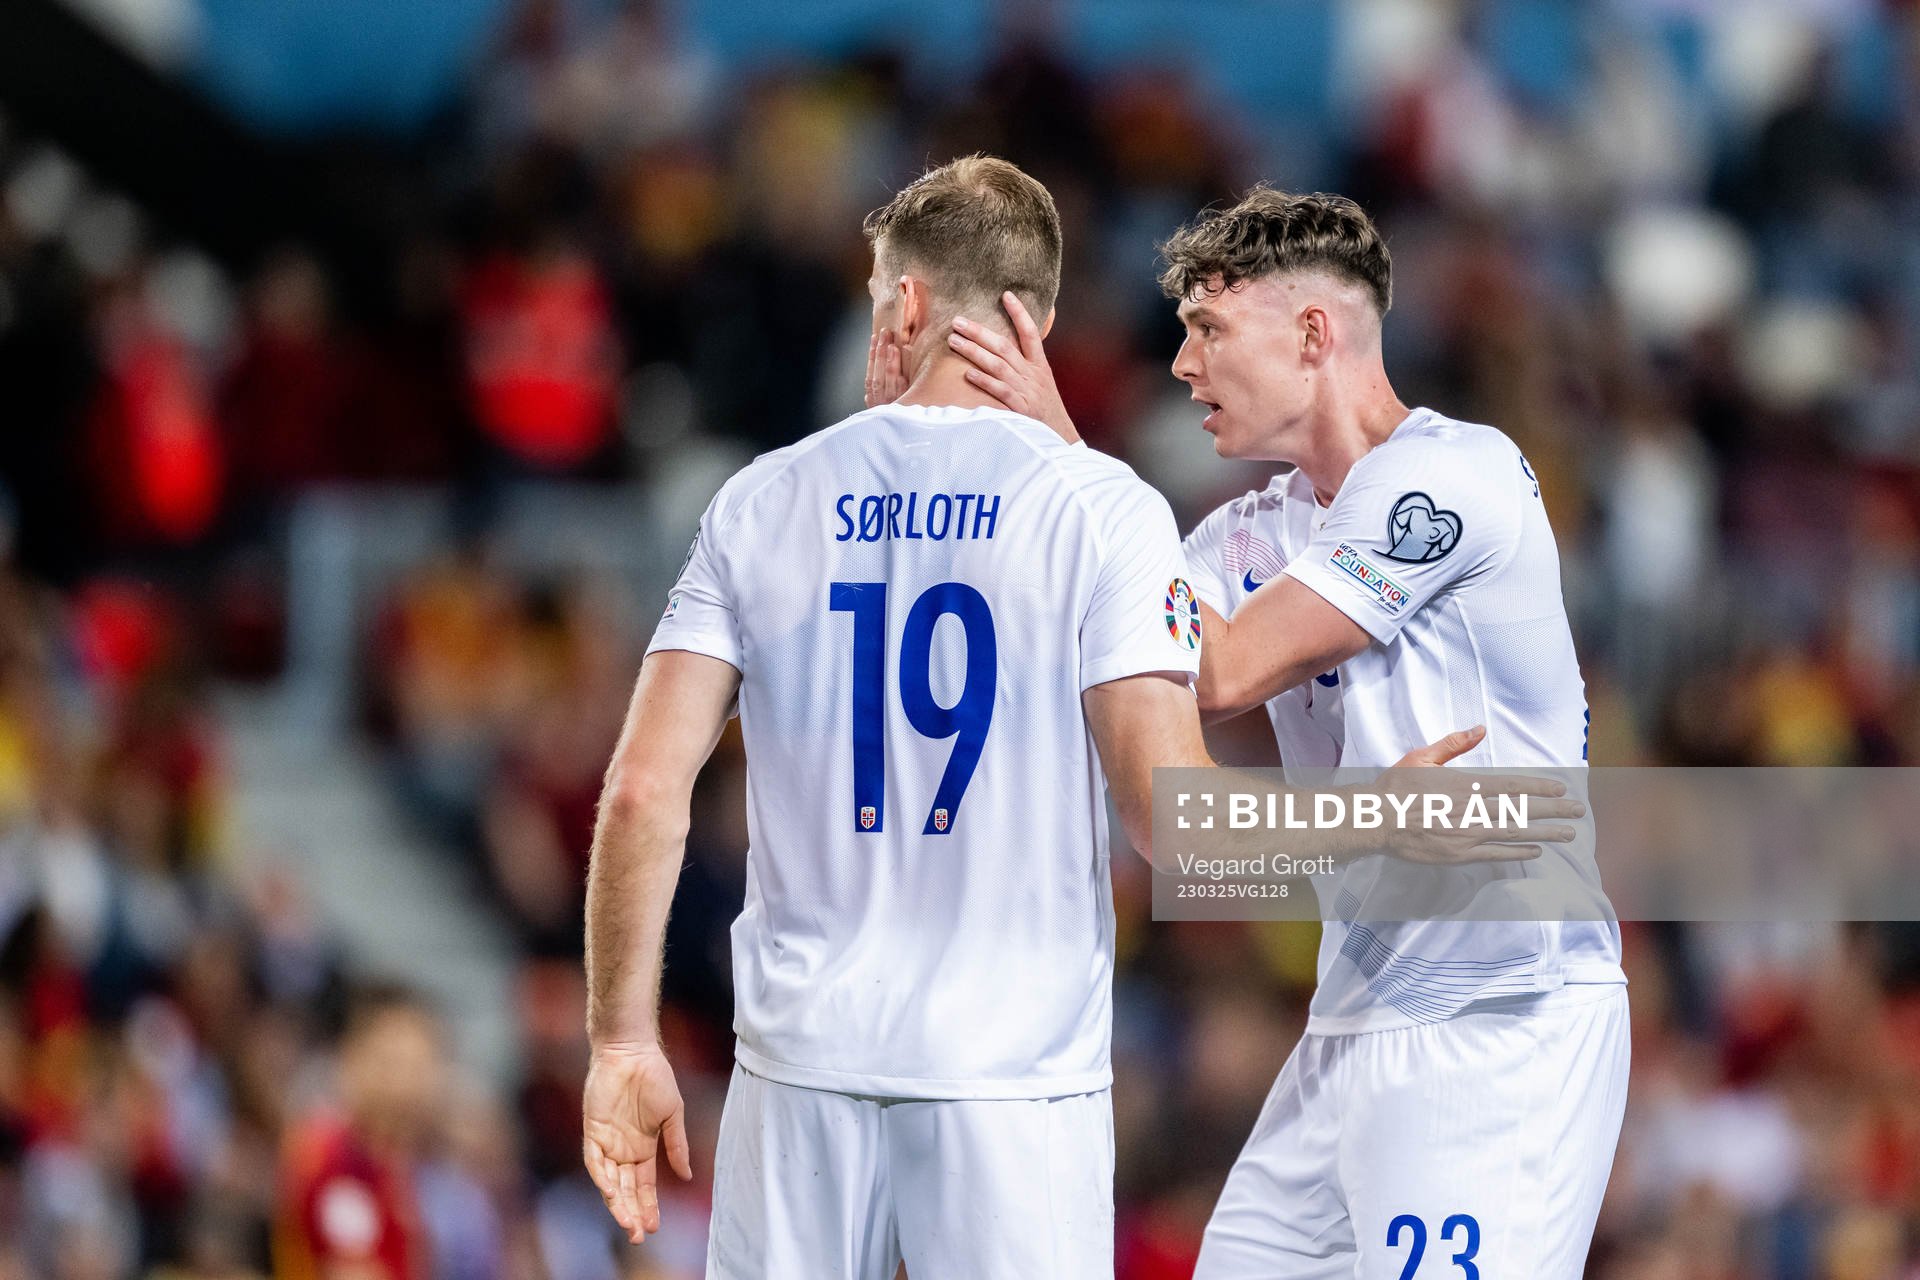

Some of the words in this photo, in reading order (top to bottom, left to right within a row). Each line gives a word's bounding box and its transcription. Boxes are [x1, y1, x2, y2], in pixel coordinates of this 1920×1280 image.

[836, 492, 1000, 542] SØRLOTH
[1339, 543, 1358, 559] UEFA
[830, 582, 997, 835] 19
[1386, 1214, 1480, 1280] 23
